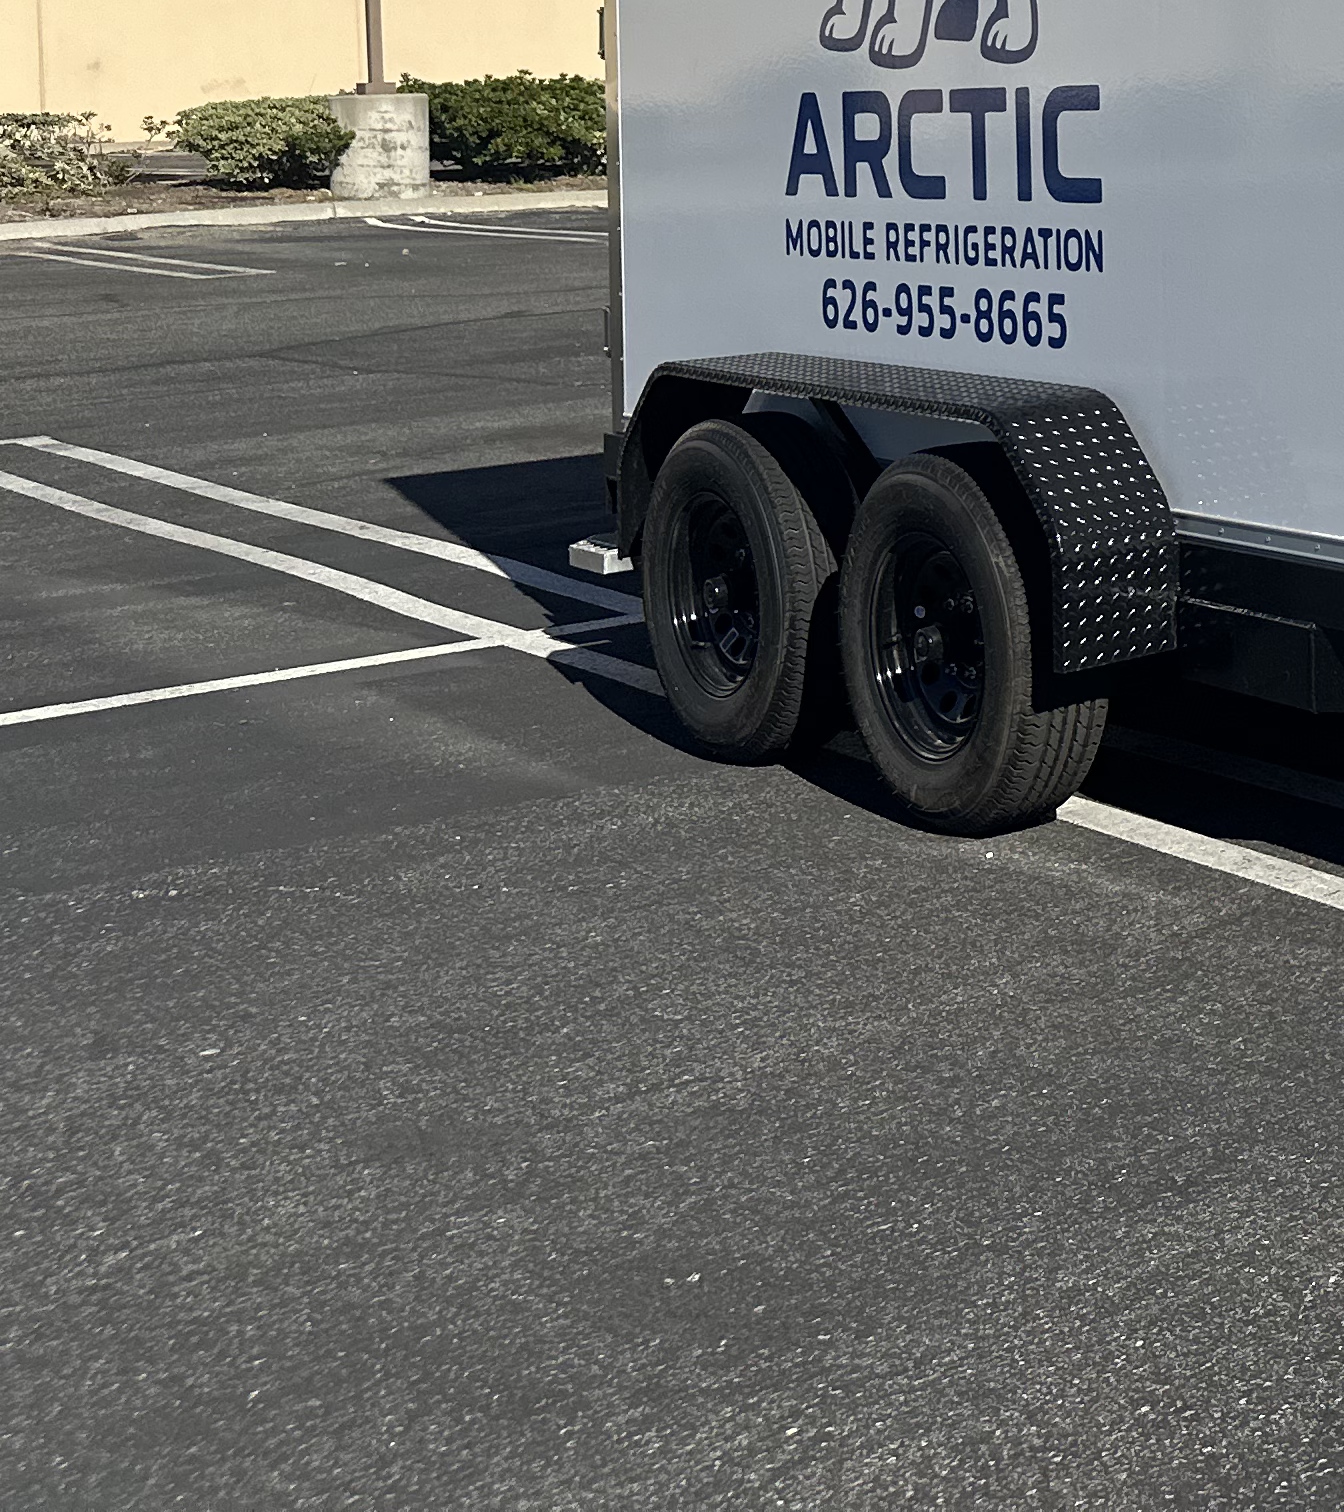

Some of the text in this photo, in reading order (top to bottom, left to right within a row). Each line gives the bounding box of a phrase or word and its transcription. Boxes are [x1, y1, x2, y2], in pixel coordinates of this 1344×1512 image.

[784, 84, 1103, 203] ARCTIC
[785, 218, 1104, 273] MOBILE REFRIGERATION
[822, 277, 1068, 349] 626-955-8665
